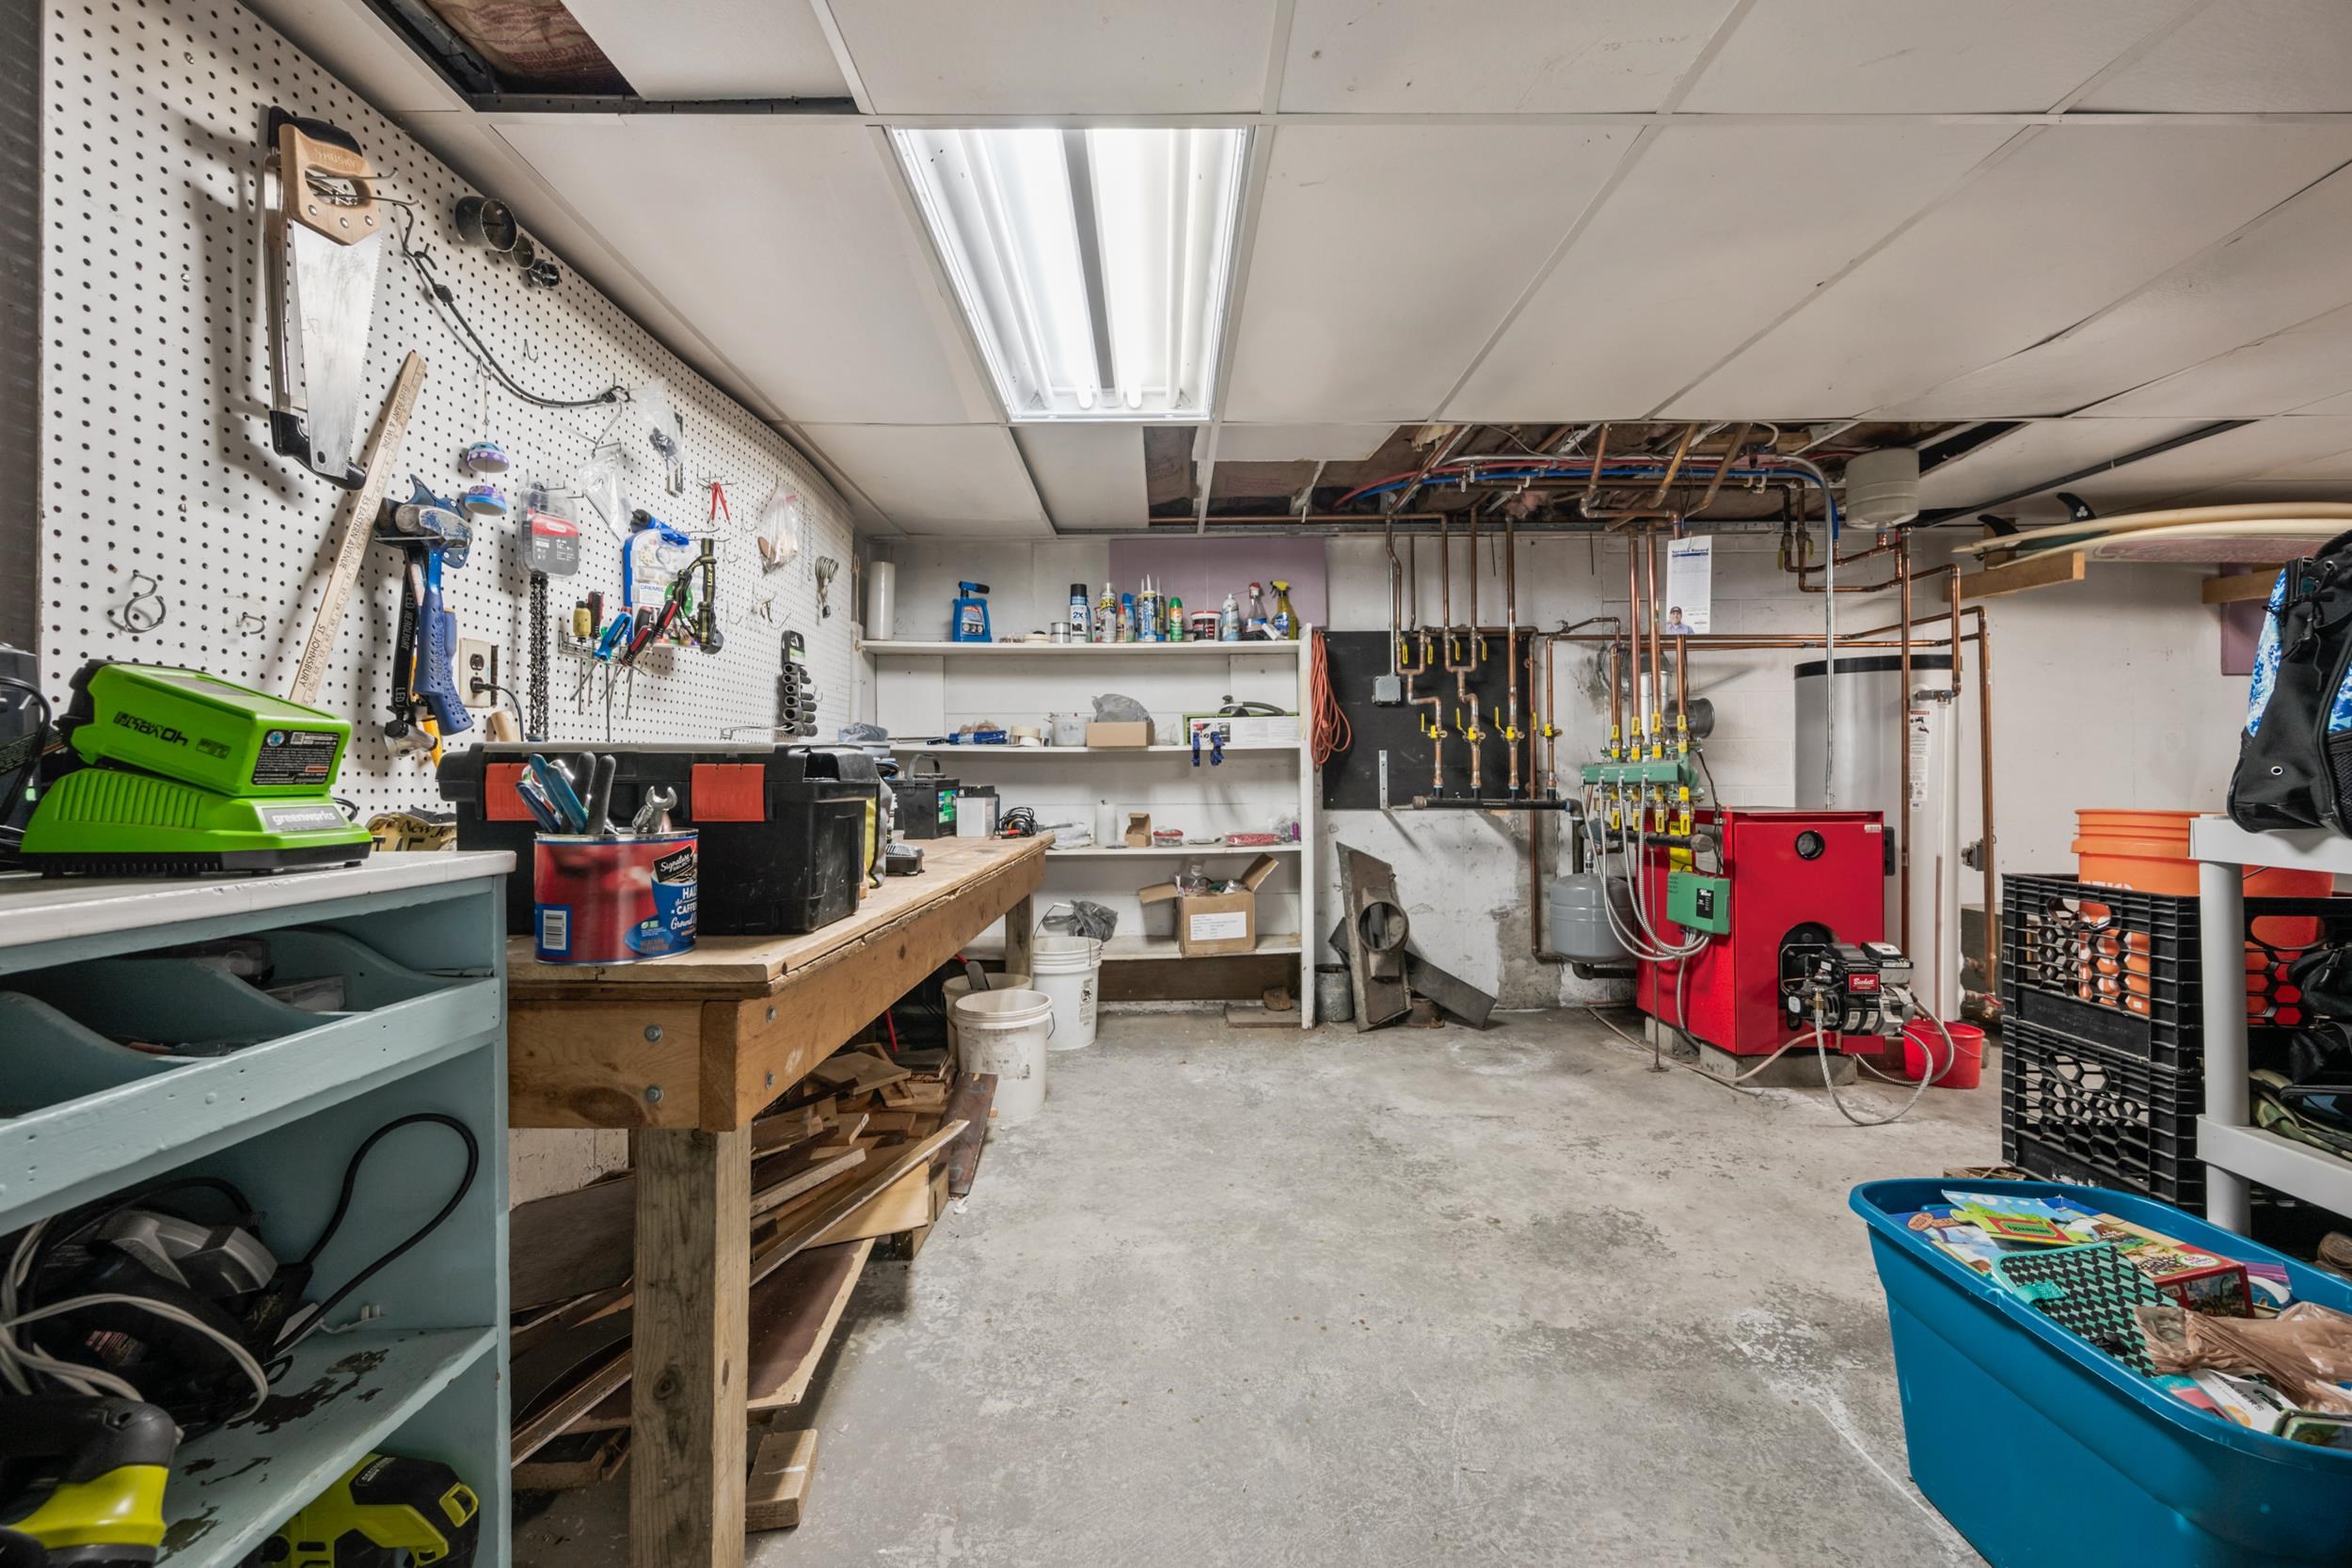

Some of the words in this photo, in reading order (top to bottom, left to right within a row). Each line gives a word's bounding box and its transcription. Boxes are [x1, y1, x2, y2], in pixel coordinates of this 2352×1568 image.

[350, 505, 366, 538] EASTERN
[339, 538, 354, 570] AVENUE
[400, 610, 413, 651] HEADLIGHT
[298, 636, 320, 688] JOHNSBURY
[394, 687, 405, 703] LED
[271, 810, 336, 826] greenworks
[660, 854, 691, 873] Signature
